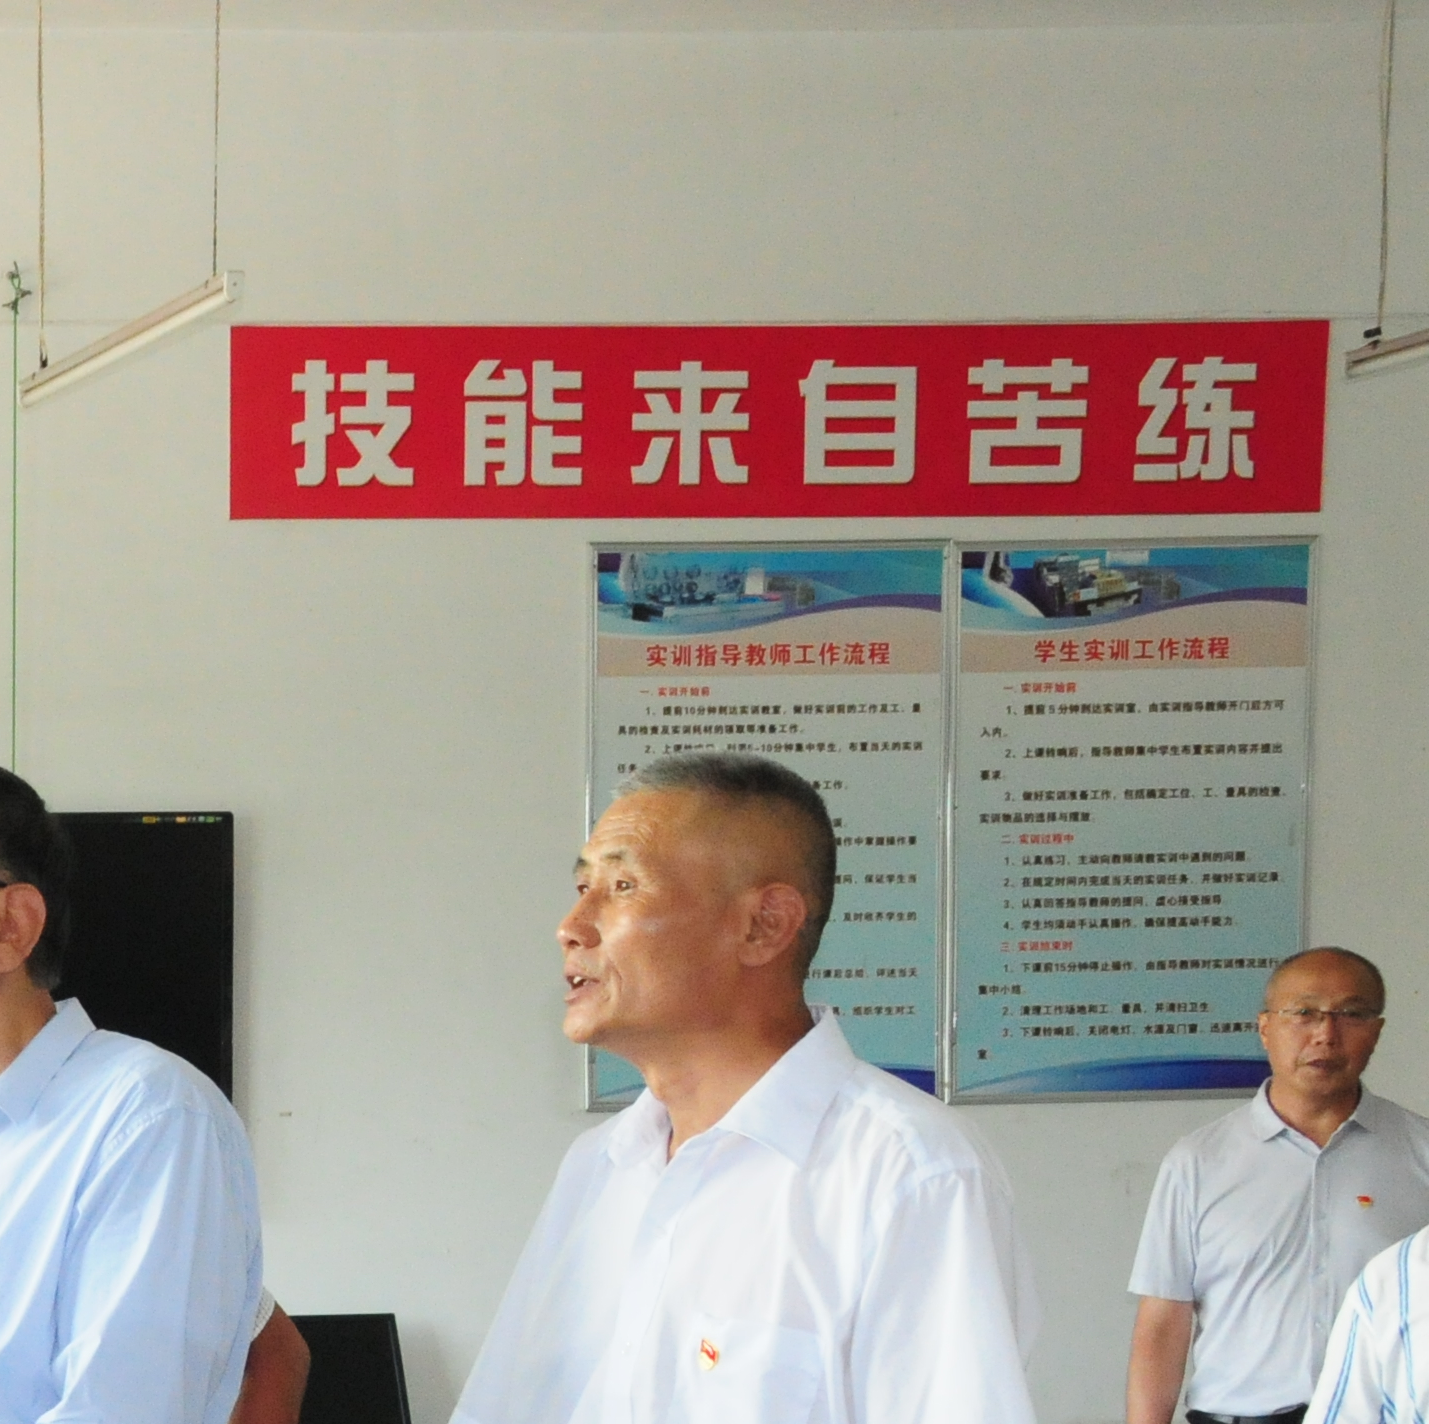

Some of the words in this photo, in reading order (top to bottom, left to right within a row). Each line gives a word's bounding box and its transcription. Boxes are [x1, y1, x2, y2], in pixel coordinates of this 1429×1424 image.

[291, 356, 1258, 487] 技能来自苦练
[646, 642, 891, 667] 实训指导教师工作流程
[1034, 636, 1230, 663] 学生实训工作流程
